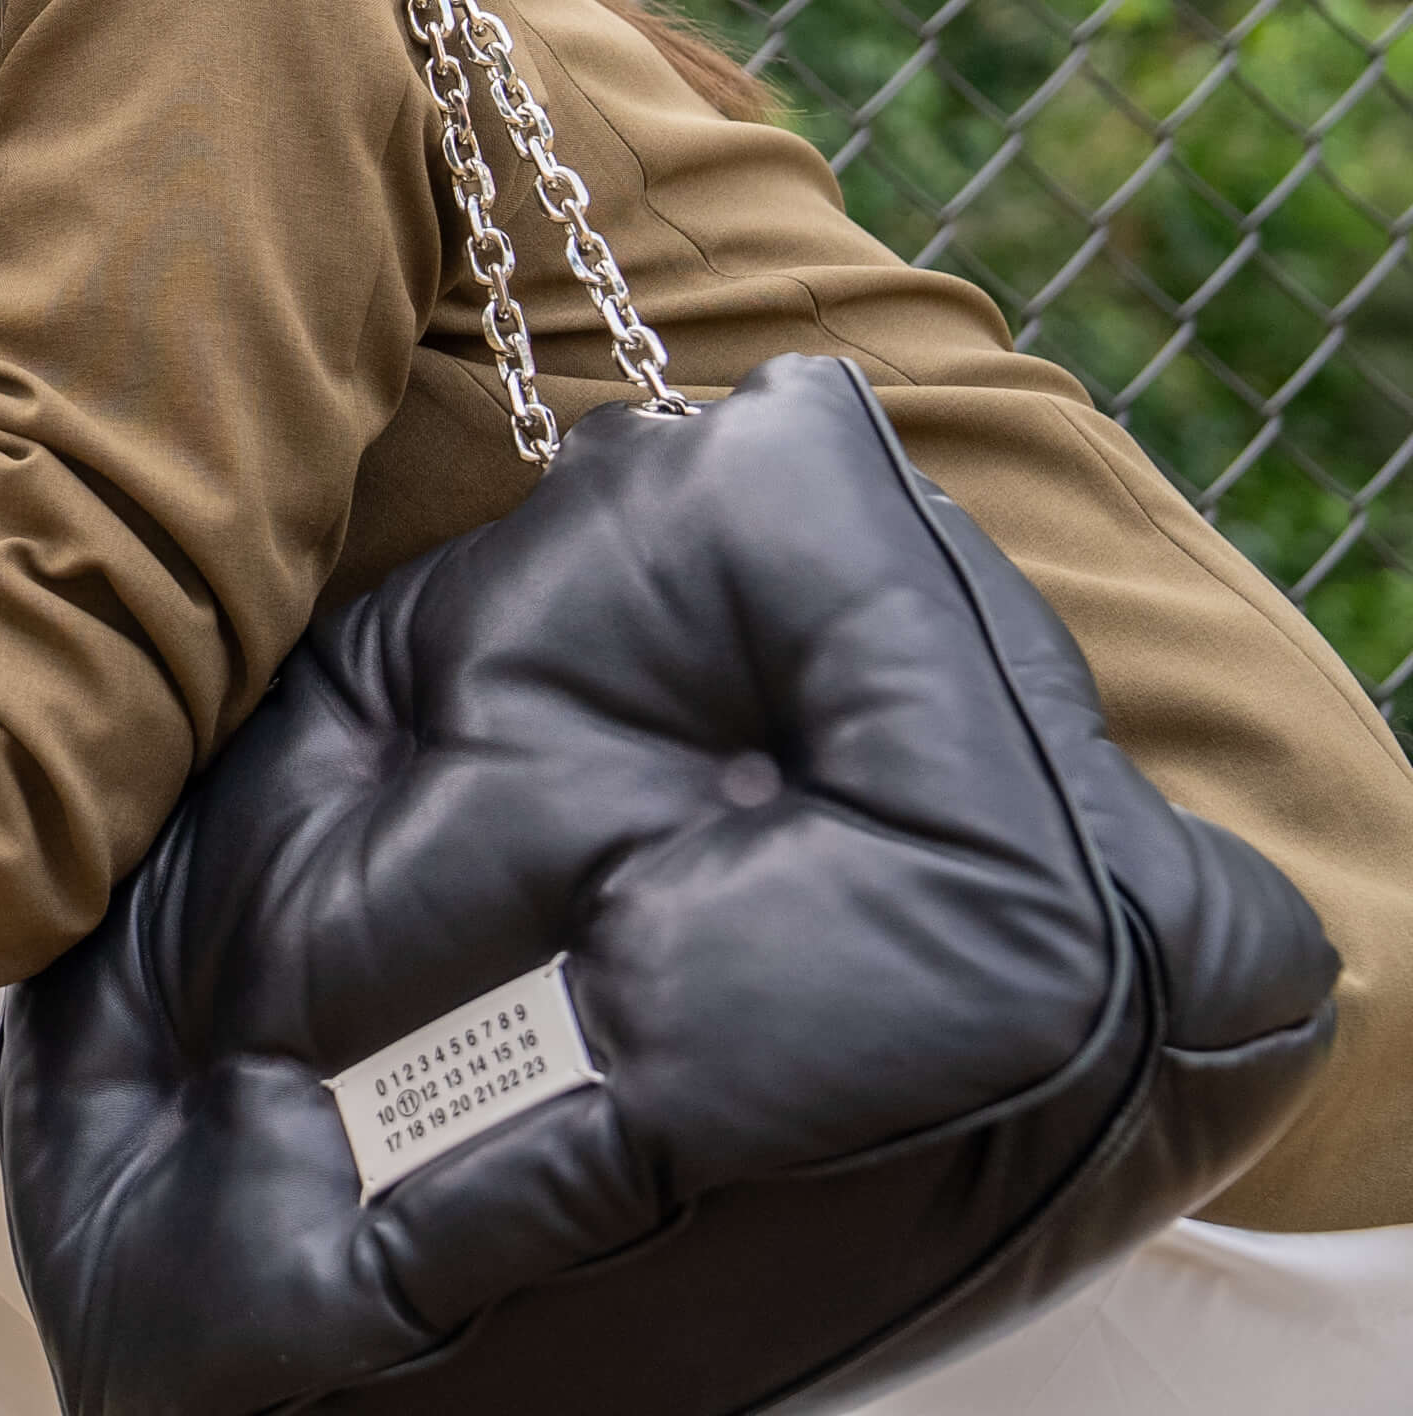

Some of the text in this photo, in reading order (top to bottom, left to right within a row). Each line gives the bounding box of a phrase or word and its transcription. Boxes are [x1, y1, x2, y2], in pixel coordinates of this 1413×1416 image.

[376, 1004, 526, 1096] 0 1 2 3 4 5 6 7 8 9
[377, 1030, 537, 1125] 10 11 12 13 14 15 16
[385, 1056, 545, 1152] 17 18 19 20 21 22 23
